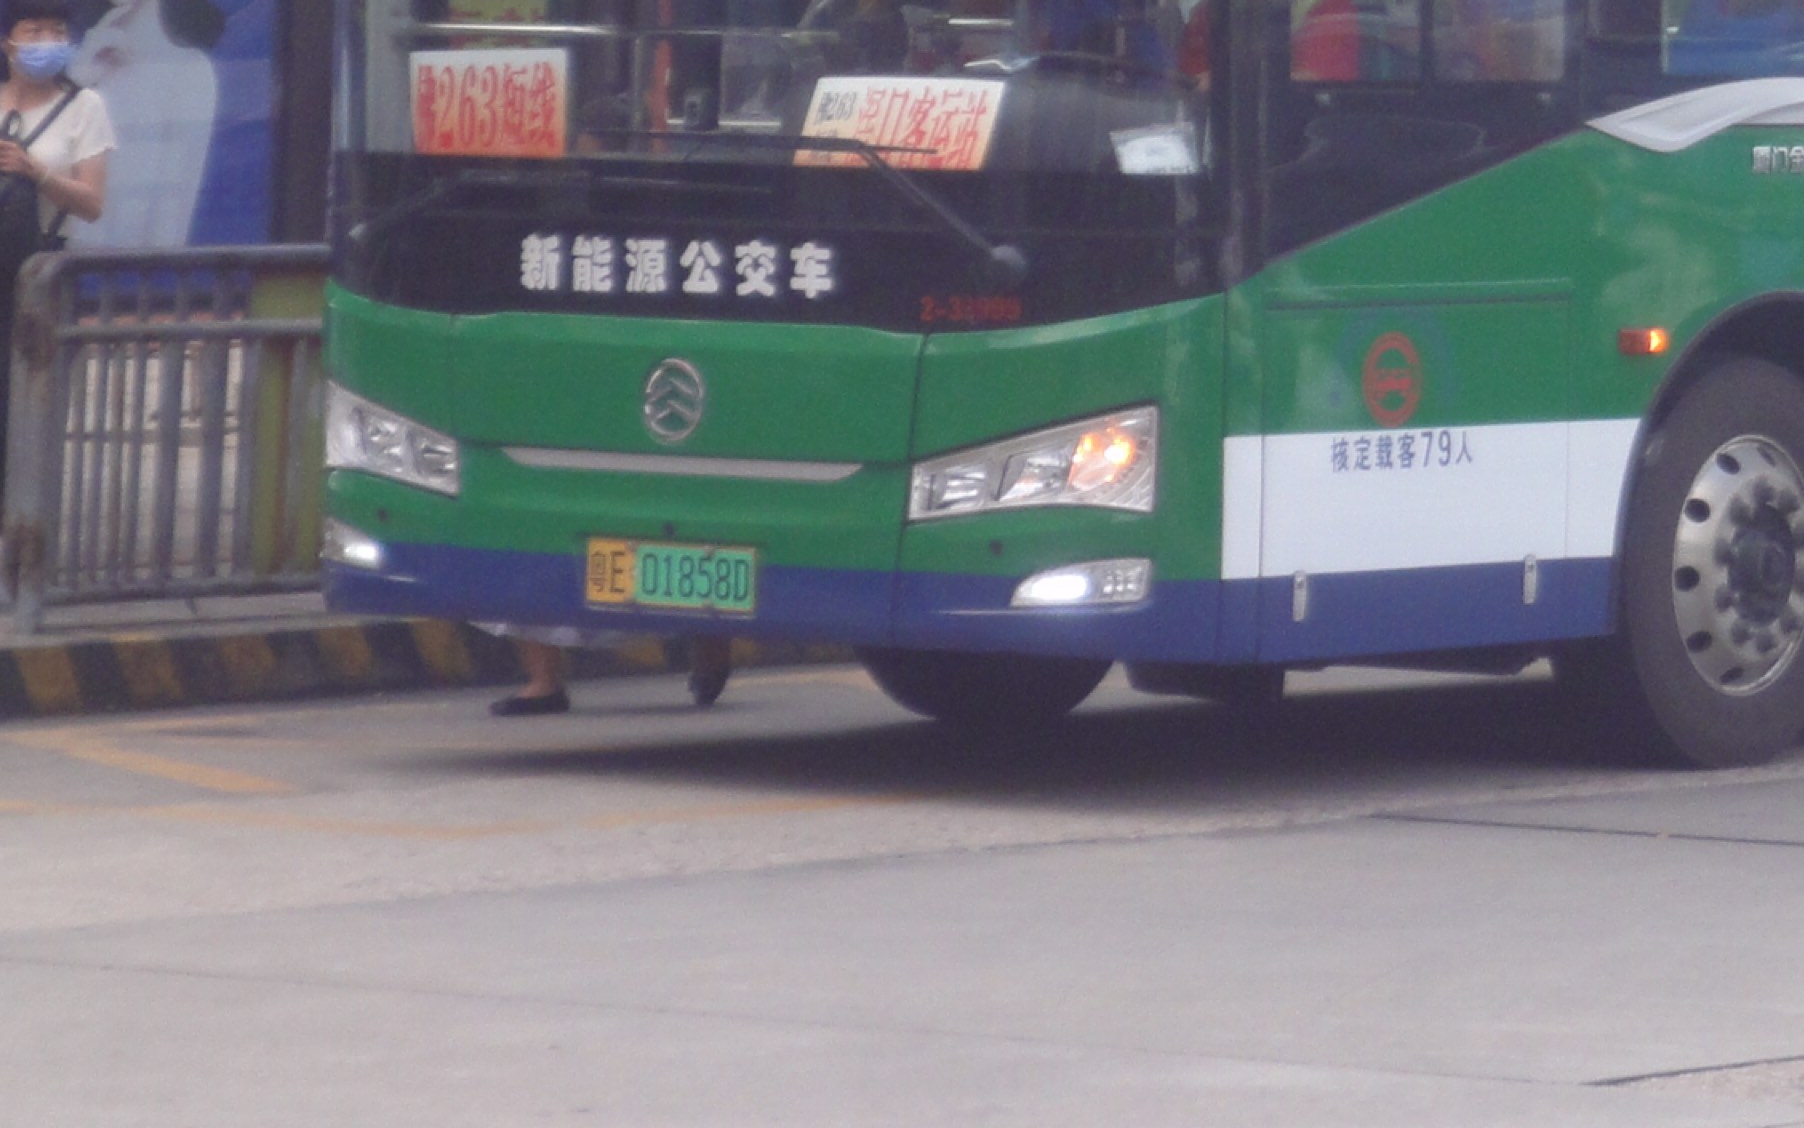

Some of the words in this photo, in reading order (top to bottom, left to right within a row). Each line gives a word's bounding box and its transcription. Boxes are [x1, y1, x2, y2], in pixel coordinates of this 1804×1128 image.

[520, 232, 834, 298] 新能源公交车
[1331, 429, 1473, 473] 核定载客79人
